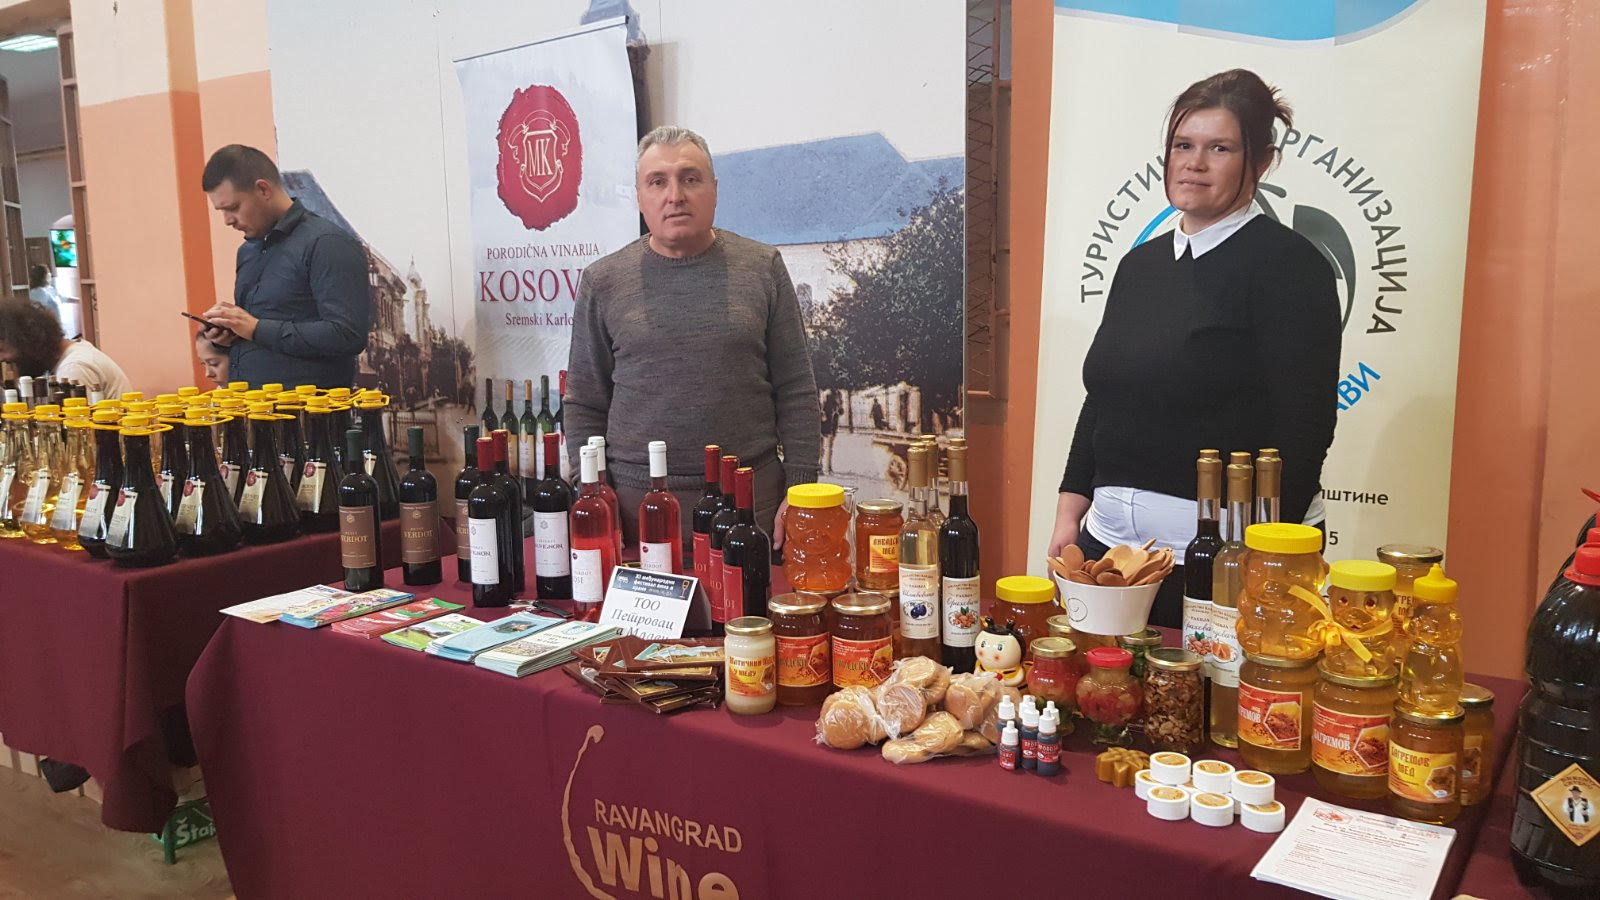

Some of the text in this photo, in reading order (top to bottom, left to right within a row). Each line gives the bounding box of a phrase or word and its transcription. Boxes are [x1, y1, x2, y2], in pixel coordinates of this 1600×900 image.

[528, 138, 553, 177] MK
[487, 242, 601, 260] PORODIČNA VINARIJA
[505, 312, 543, 327] Sremski
[403, 529, 433, 539] VERDOT
[1328, 531, 1339, 545] 5
[635, 597, 661, 612] ТОО
[616, 626, 624, 636] а
[594, 798, 743, 854] RAVANGRAD
[587, 826, 740, 900] Wine
